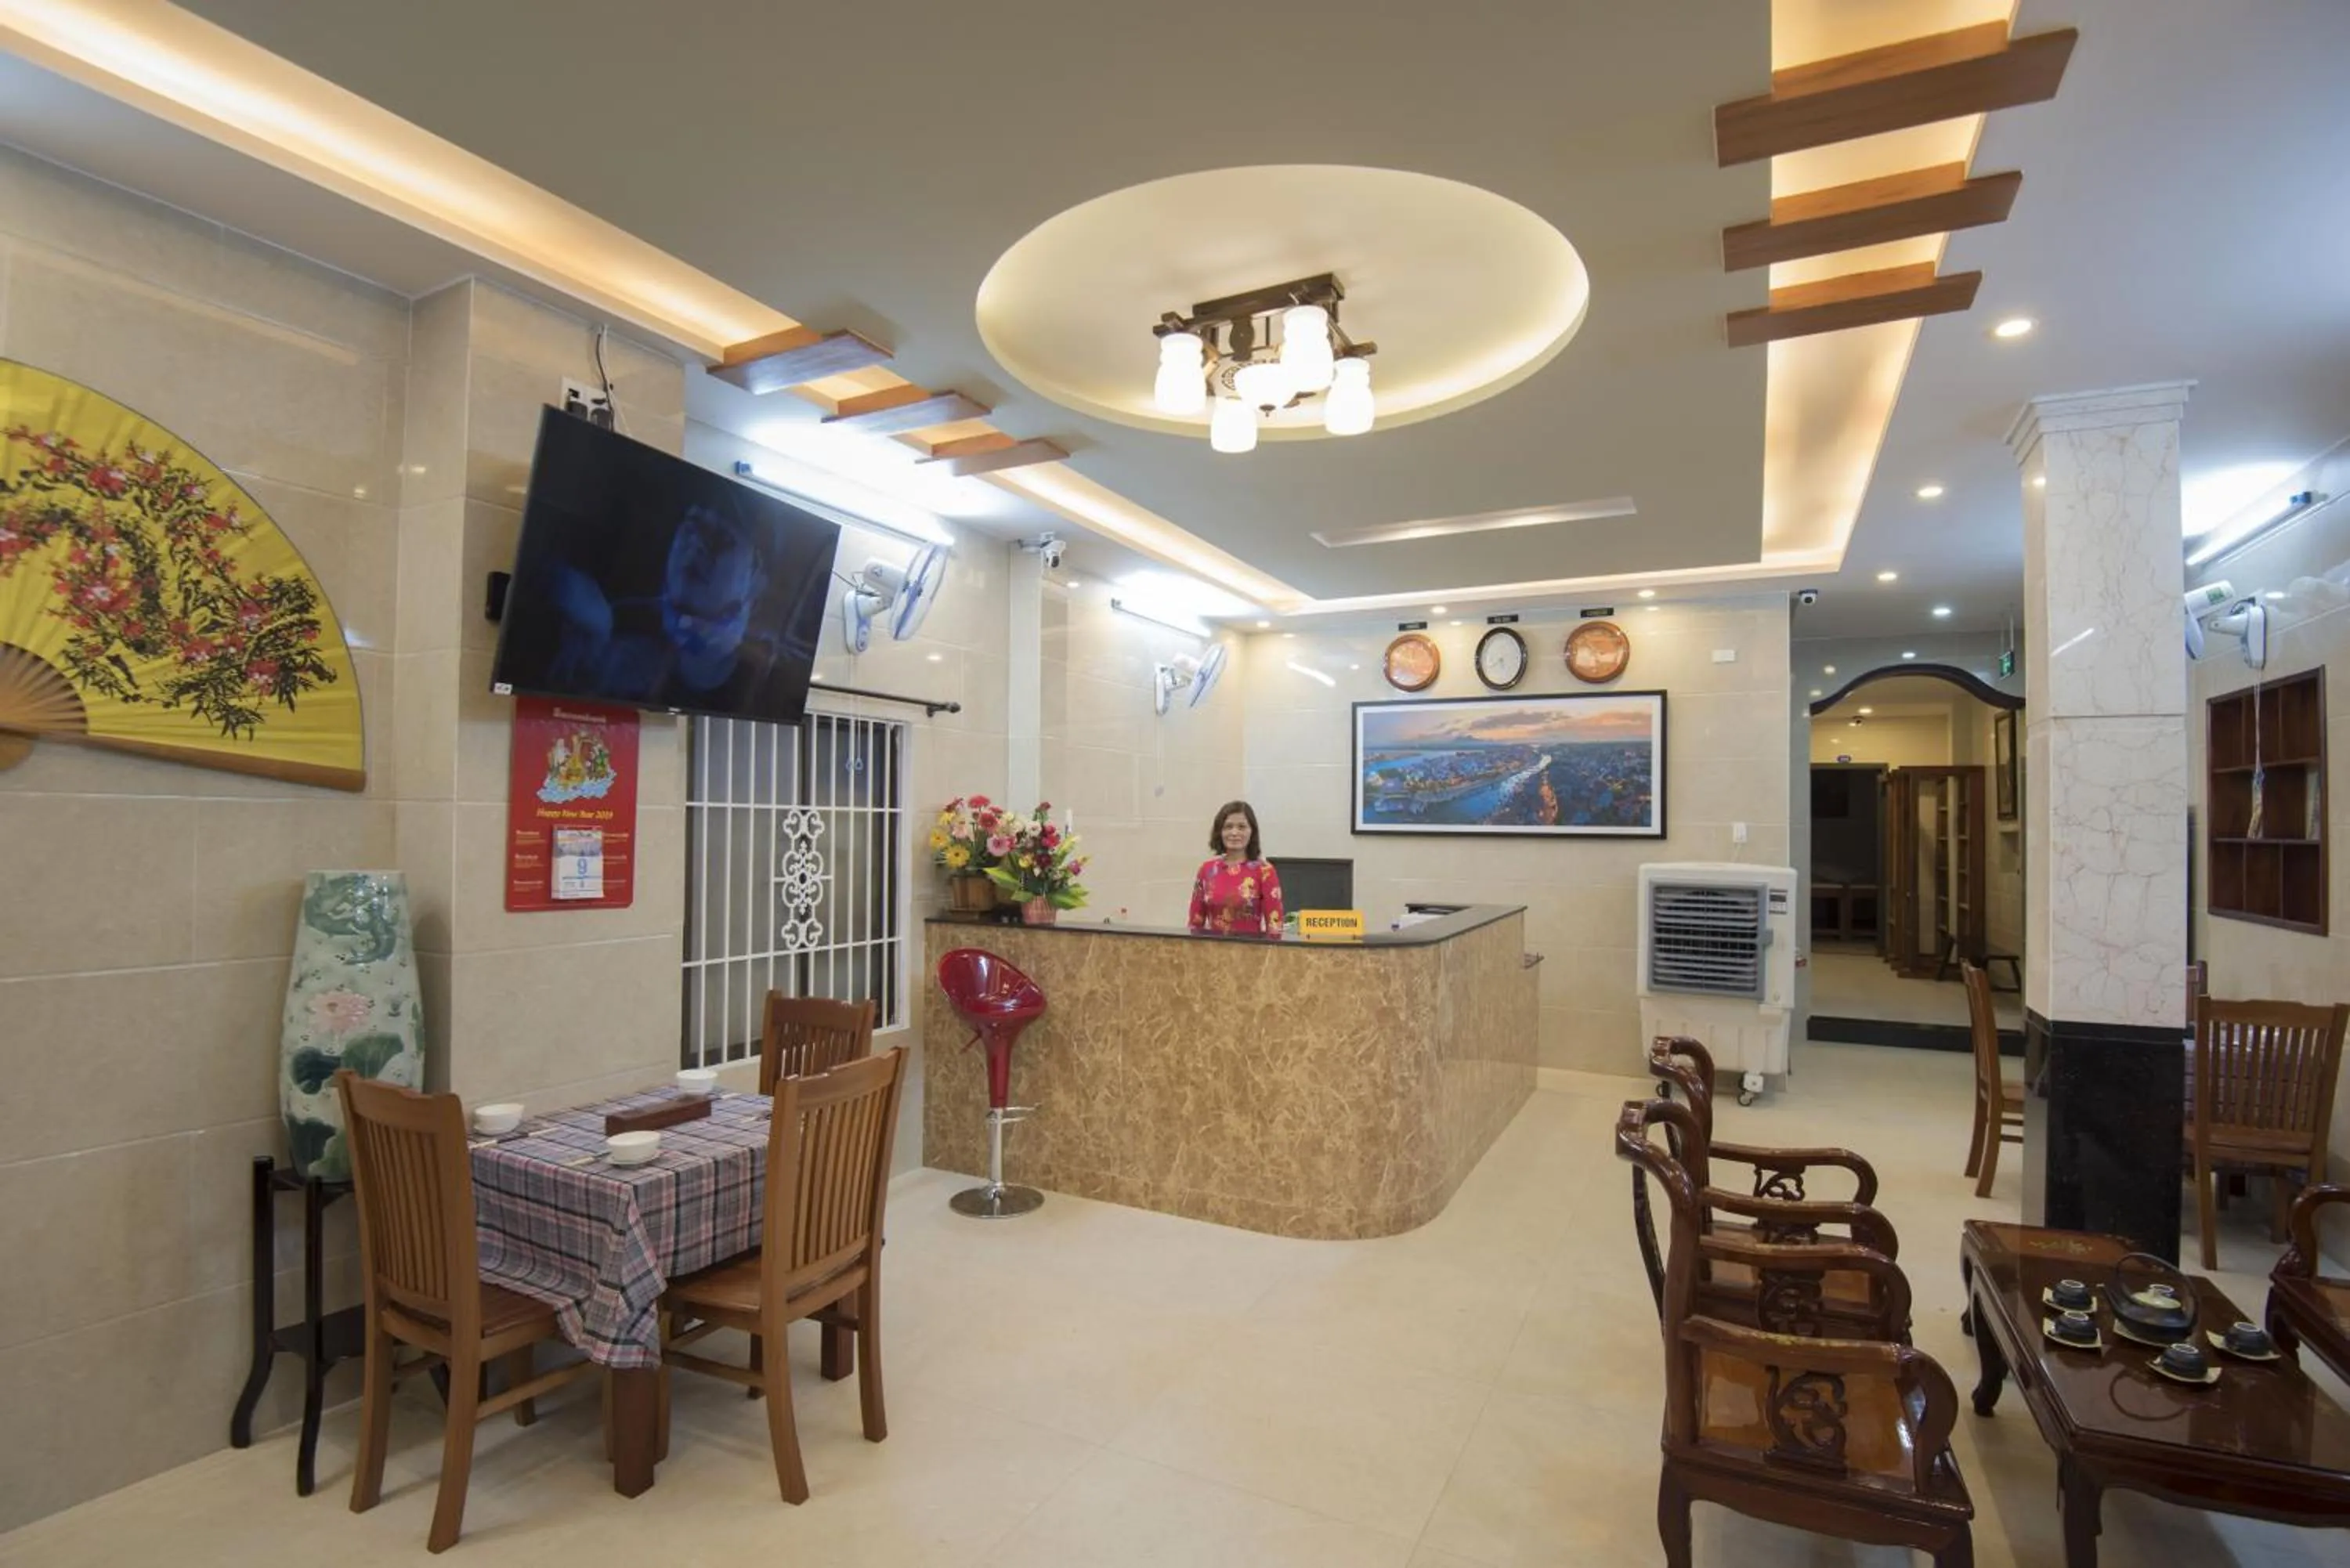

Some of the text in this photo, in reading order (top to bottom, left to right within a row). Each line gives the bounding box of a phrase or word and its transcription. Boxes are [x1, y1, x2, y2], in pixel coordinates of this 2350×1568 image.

[536, 807, 562, 818] Happy
[562, 808, 577, 818] New
[577, 858, 588, 875] 9
[1306, 917, 1358, 928] RECEPTION
